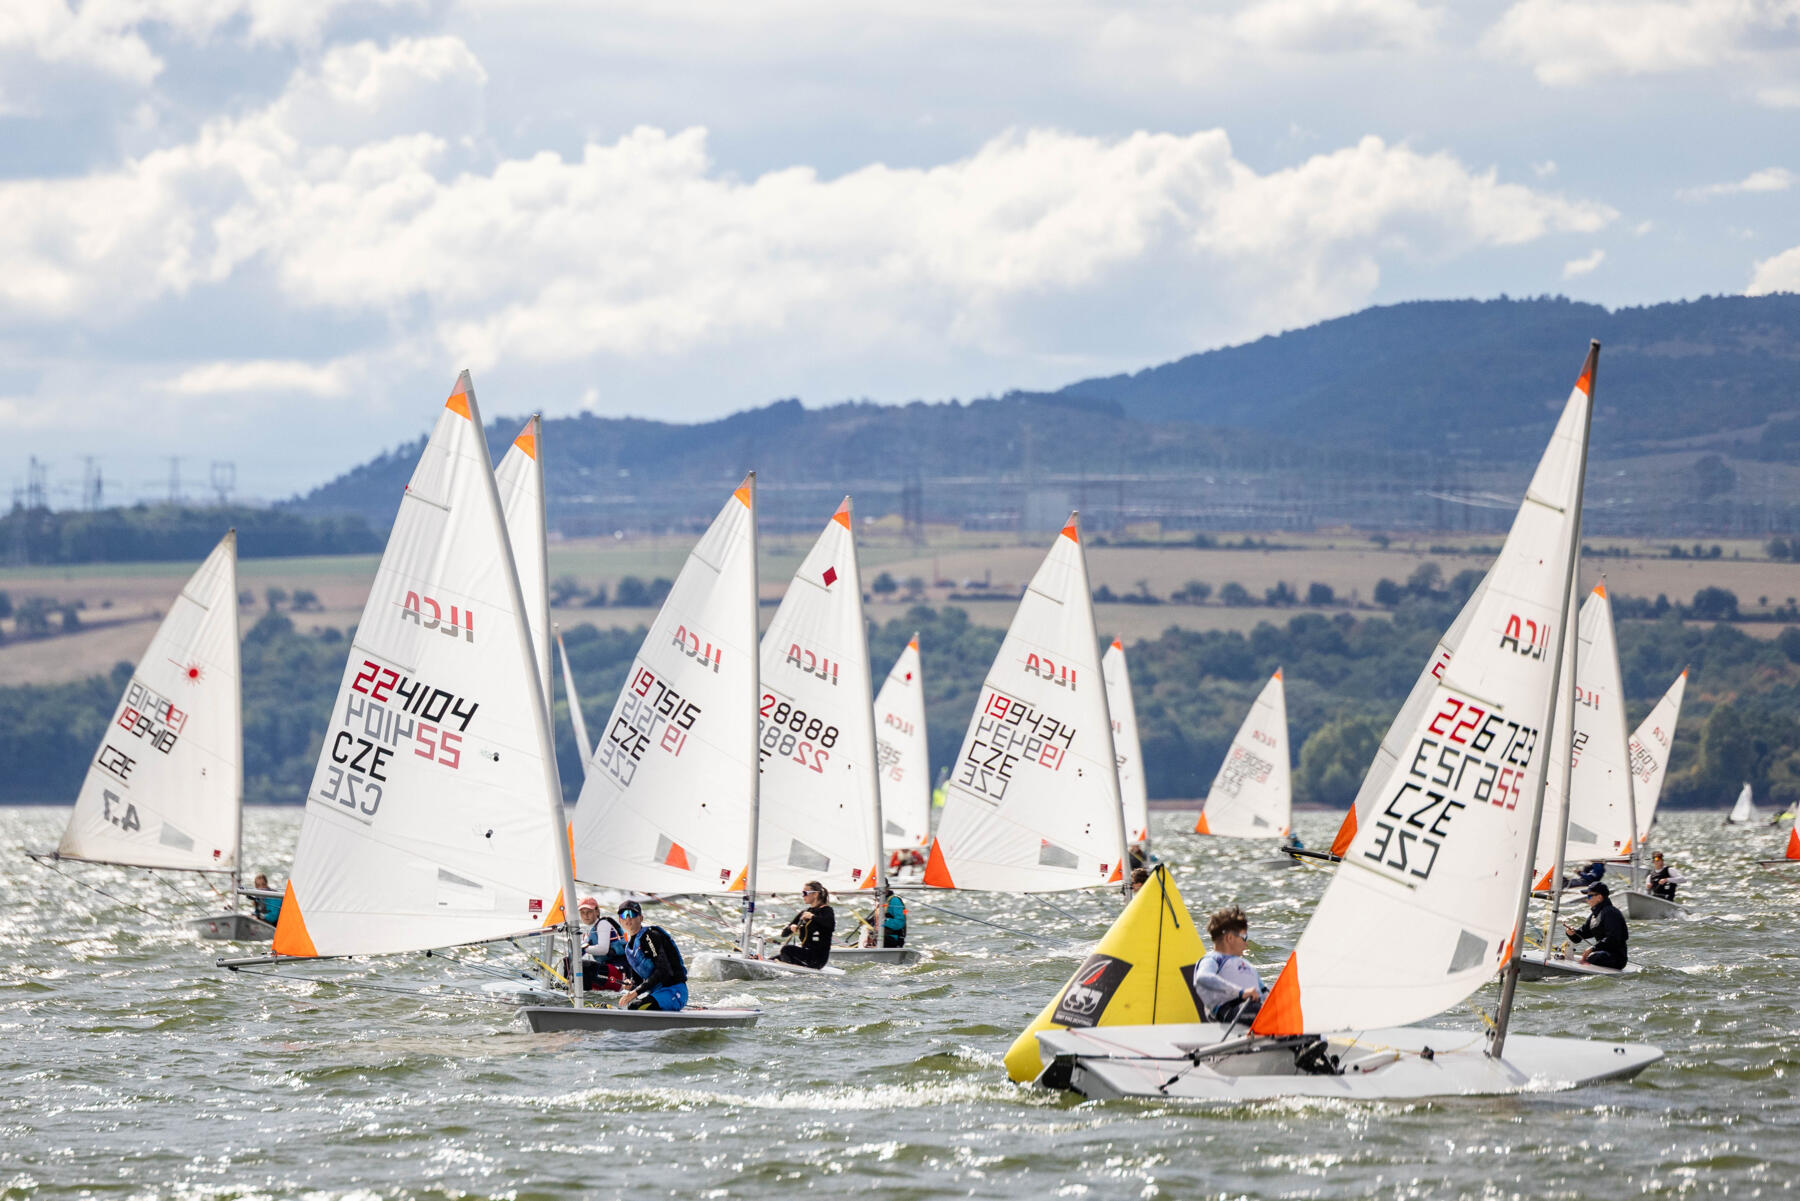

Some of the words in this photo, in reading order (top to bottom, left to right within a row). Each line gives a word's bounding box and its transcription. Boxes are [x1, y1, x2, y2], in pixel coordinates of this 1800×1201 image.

[351, 660, 480, 732] 224104
[631, 667, 701, 730] 197515
[760, 694, 839, 748] 28888
[984, 693, 1076, 749] 199434
[117, 706, 178, 755] 199418
[332, 731, 394, 782] CZE
[610, 717, 650, 761] CZE
[1428, 697, 1538, 768] 226723
[98, 744, 137, 780] CZE
[967, 739, 1019, 778] CZE
[1383, 781, 1466, 838] CZE
